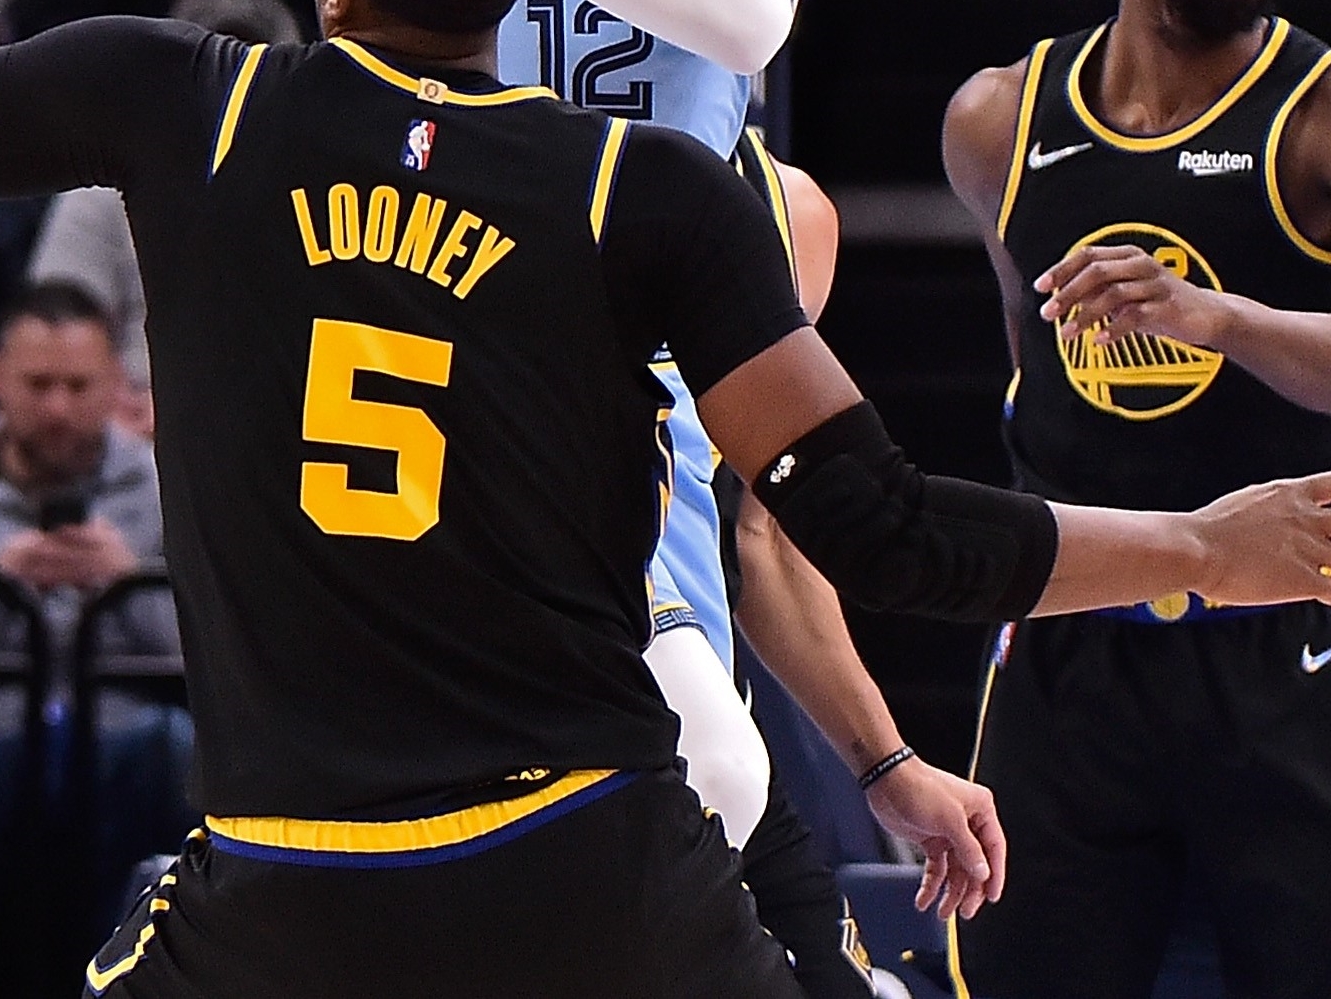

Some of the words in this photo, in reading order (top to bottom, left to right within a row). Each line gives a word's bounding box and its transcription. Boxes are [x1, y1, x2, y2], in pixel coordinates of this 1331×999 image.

[1178, 149, 1253, 175] Rakuten
[290, 183, 516, 300] LOONEY
[299, 317, 454, 542] 5
